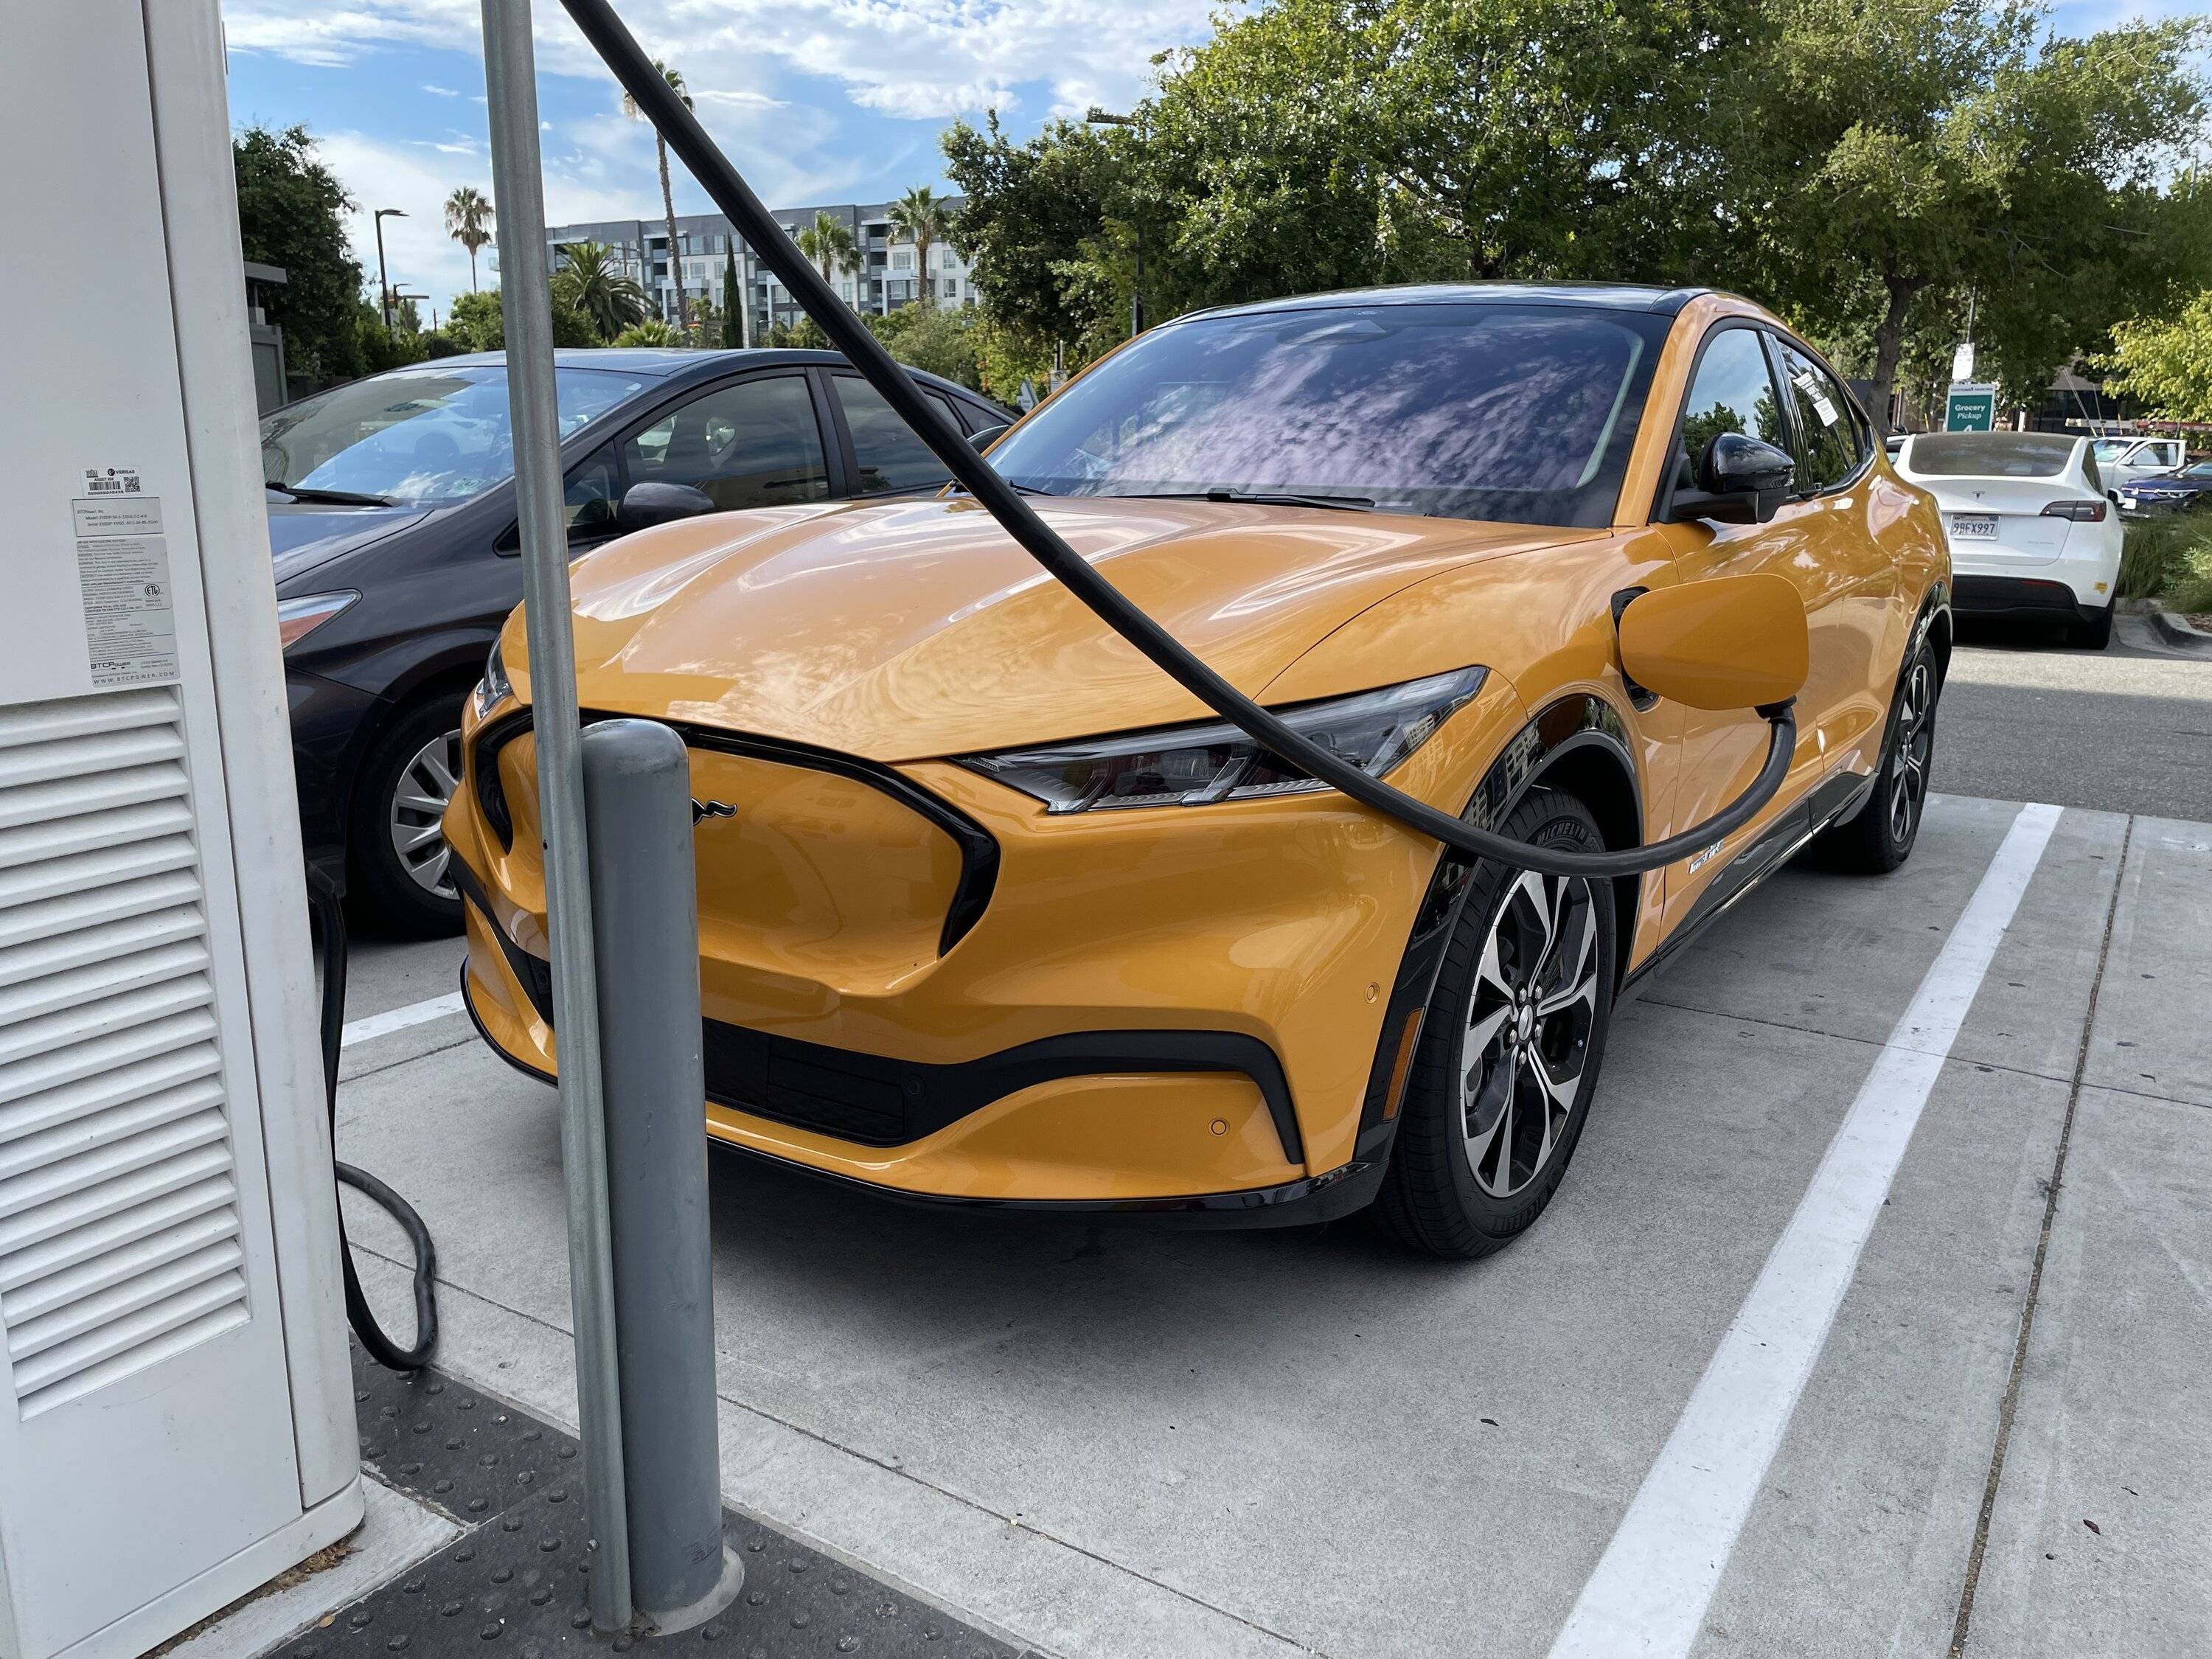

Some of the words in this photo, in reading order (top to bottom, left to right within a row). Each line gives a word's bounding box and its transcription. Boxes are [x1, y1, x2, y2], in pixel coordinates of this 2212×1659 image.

[1955, 404, 1986, 412] Grocery
[1957, 412, 1982, 420] Pickup
[1953, 523, 1995, 534] 9BFX997
[1537, 822, 1587, 847] MICHELIN
